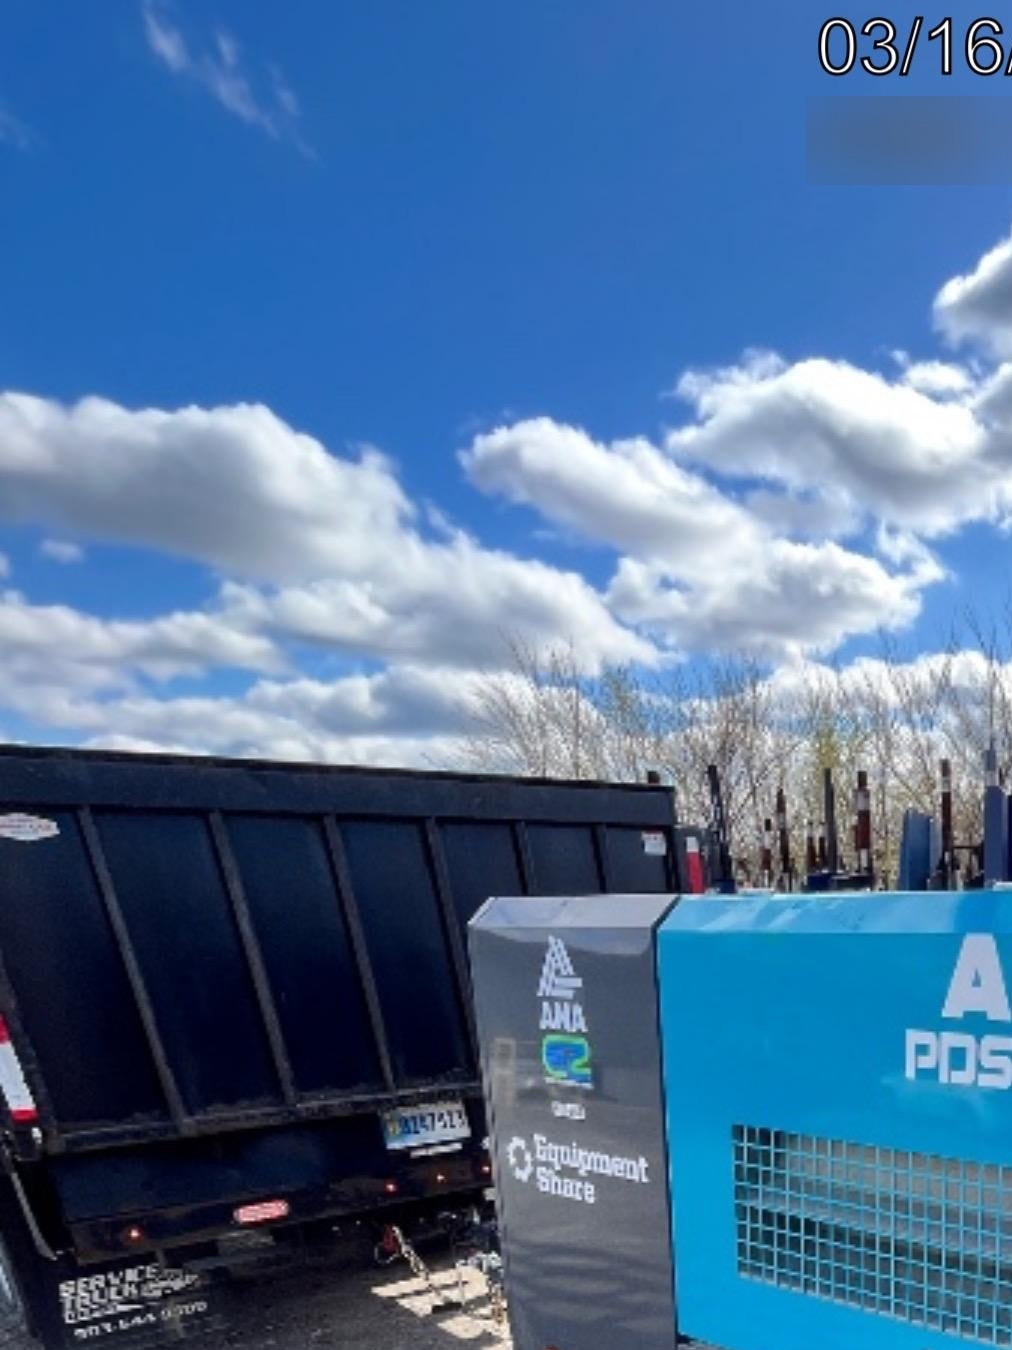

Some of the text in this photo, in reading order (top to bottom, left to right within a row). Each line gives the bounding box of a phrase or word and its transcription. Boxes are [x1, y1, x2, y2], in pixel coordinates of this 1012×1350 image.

[539, 1001, 588, 1033] ANA
[533, 1133, 649, 1184] Equipment
[536, 1166, 595, 1204] Share
